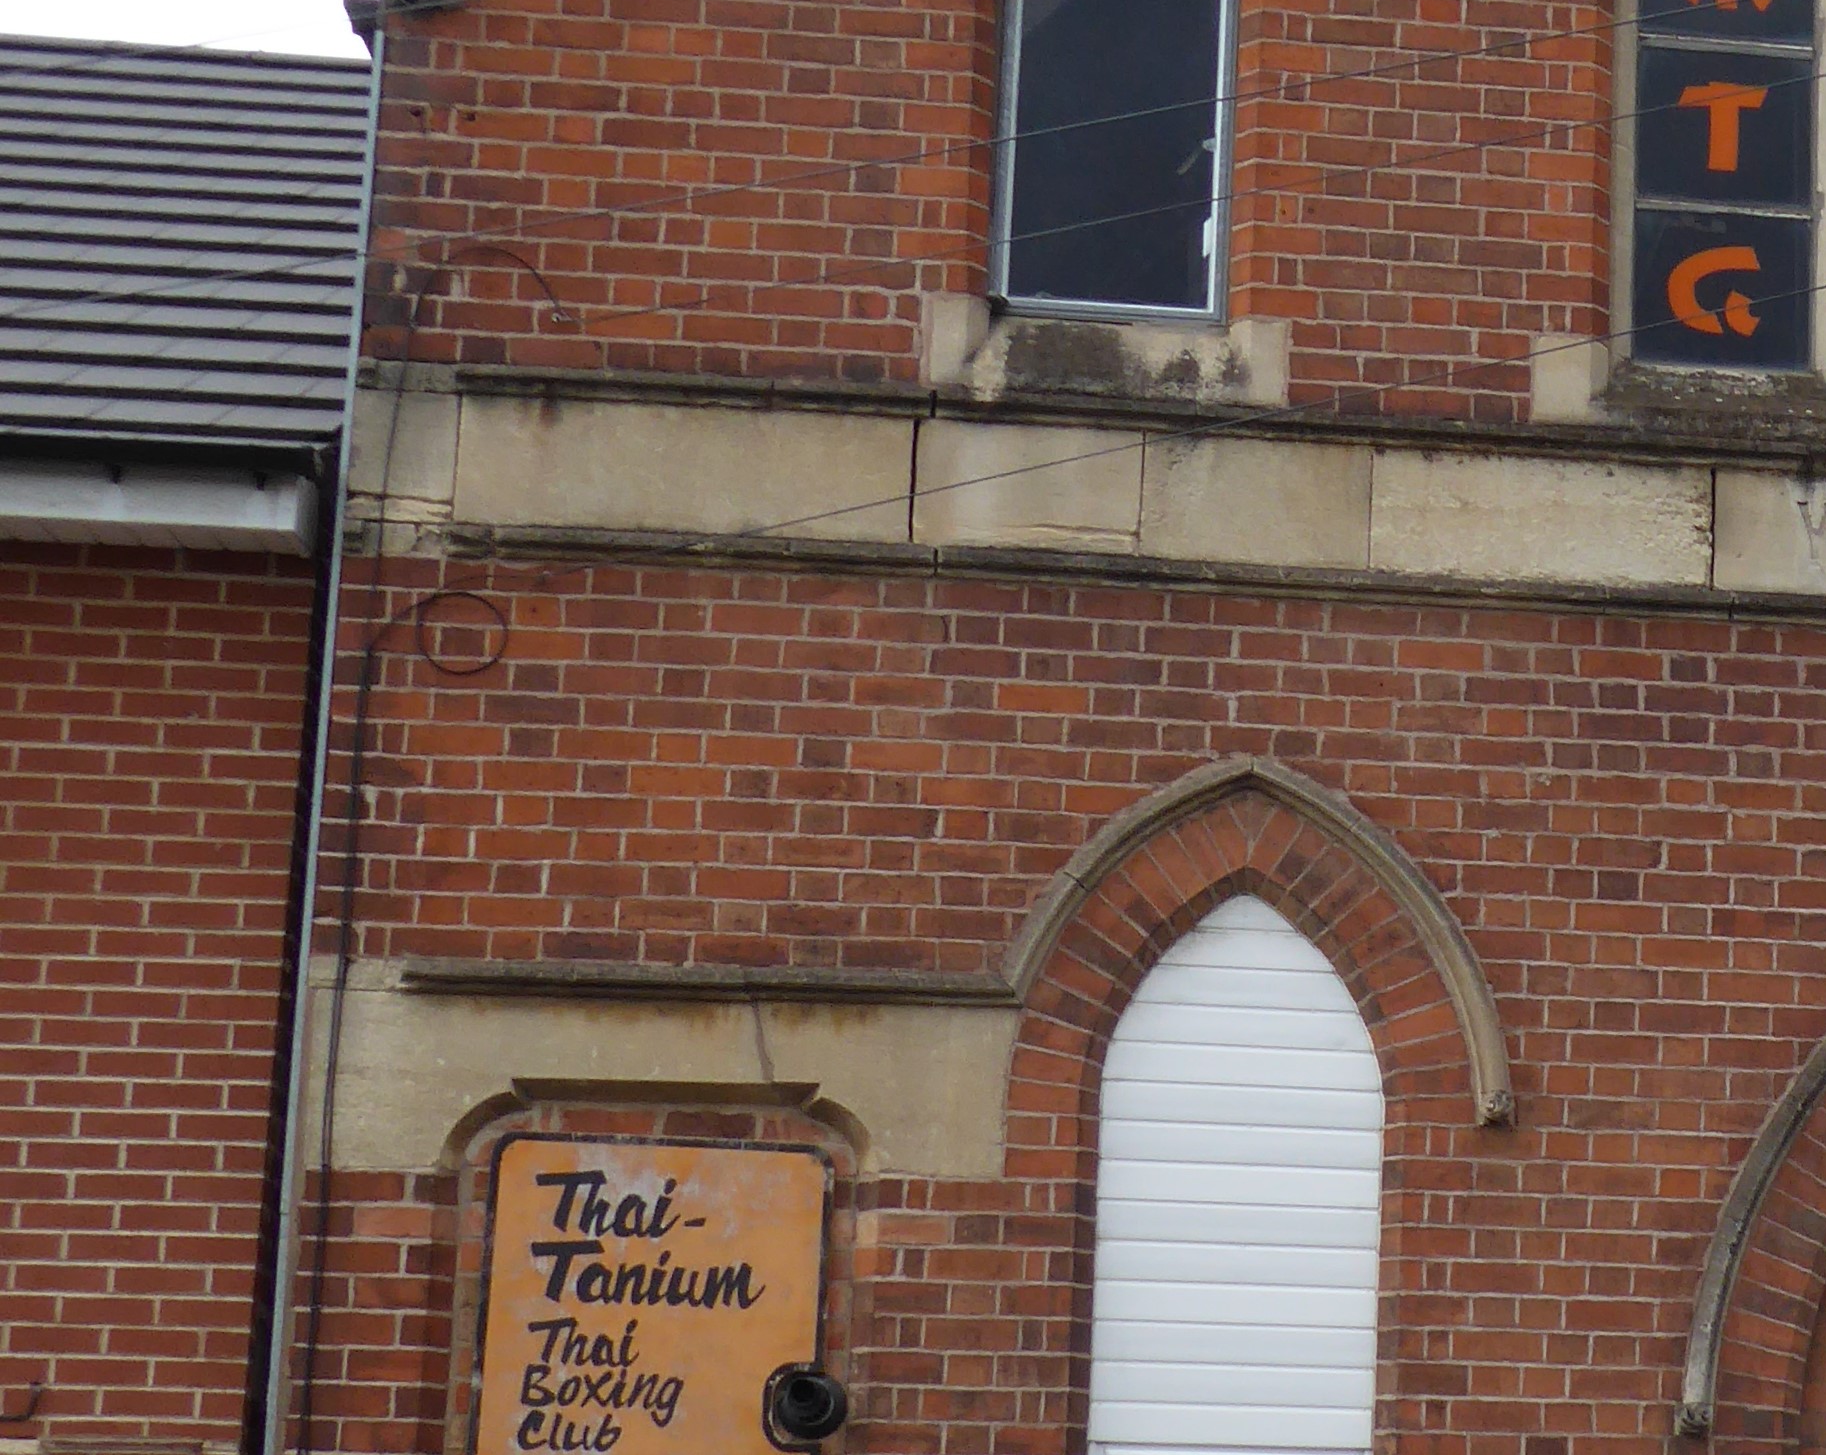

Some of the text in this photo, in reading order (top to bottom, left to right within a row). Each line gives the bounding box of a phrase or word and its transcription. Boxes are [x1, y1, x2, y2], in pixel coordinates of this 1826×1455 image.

[531, 1240, 765, 1309] Tanium
[528, 1317, 639, 1368] Thai
[521, 1364, 684, 1427] Boxing
[517, 1410, 622, 1452] Club
